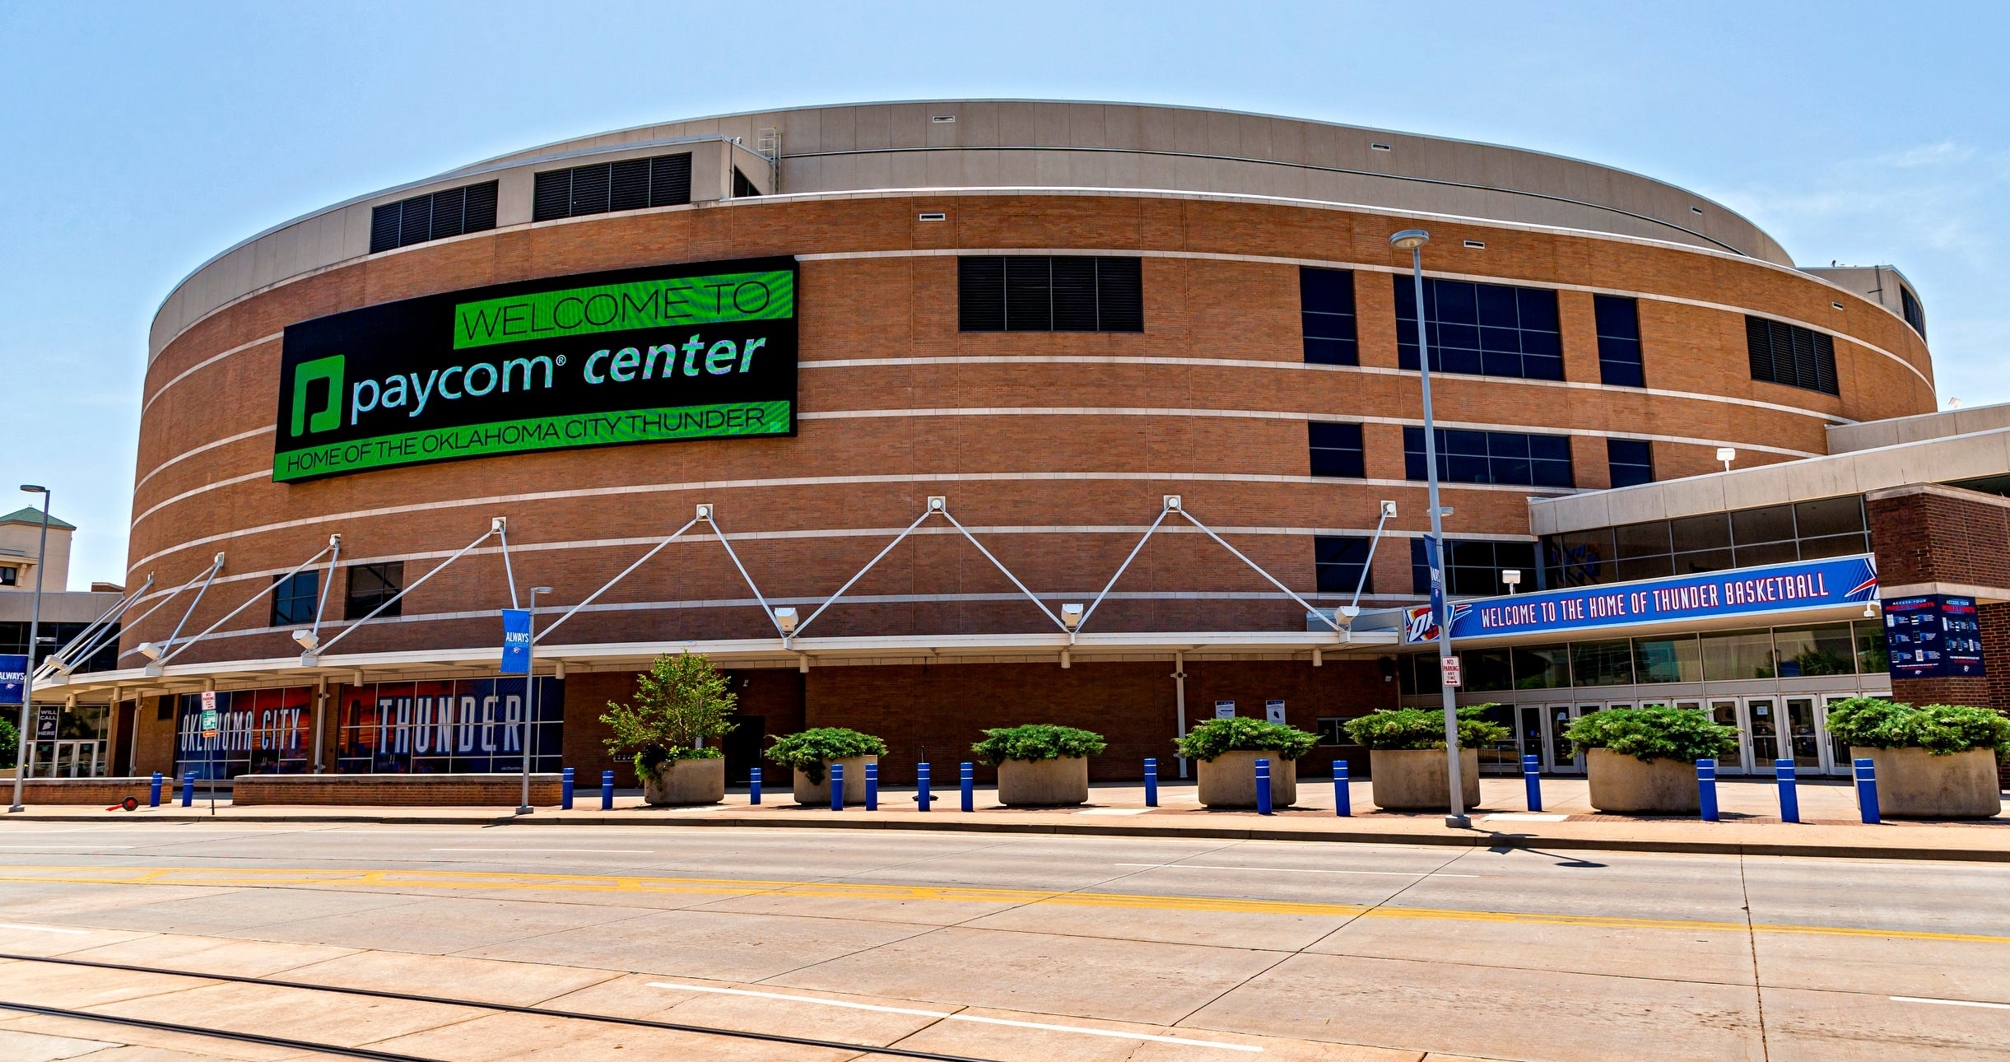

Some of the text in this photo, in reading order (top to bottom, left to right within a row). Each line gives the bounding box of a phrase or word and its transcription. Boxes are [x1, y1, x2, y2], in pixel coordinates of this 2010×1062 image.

[462, 280, 770, 341] WELCOME TO
[583, 333, 767, 386] center
[287, 407, 766, 473] HOME OF THE OKLAHOMA CITY THUNDER
[1481, 571, 1830, 628] WELCOME TO THE HOME OF THUNDER BASKETBALL
[505, 631, 530, 644] ALWAYS
[261, 707, 300, 750] CITY
[379, 694, 521, 754] THUNDER
